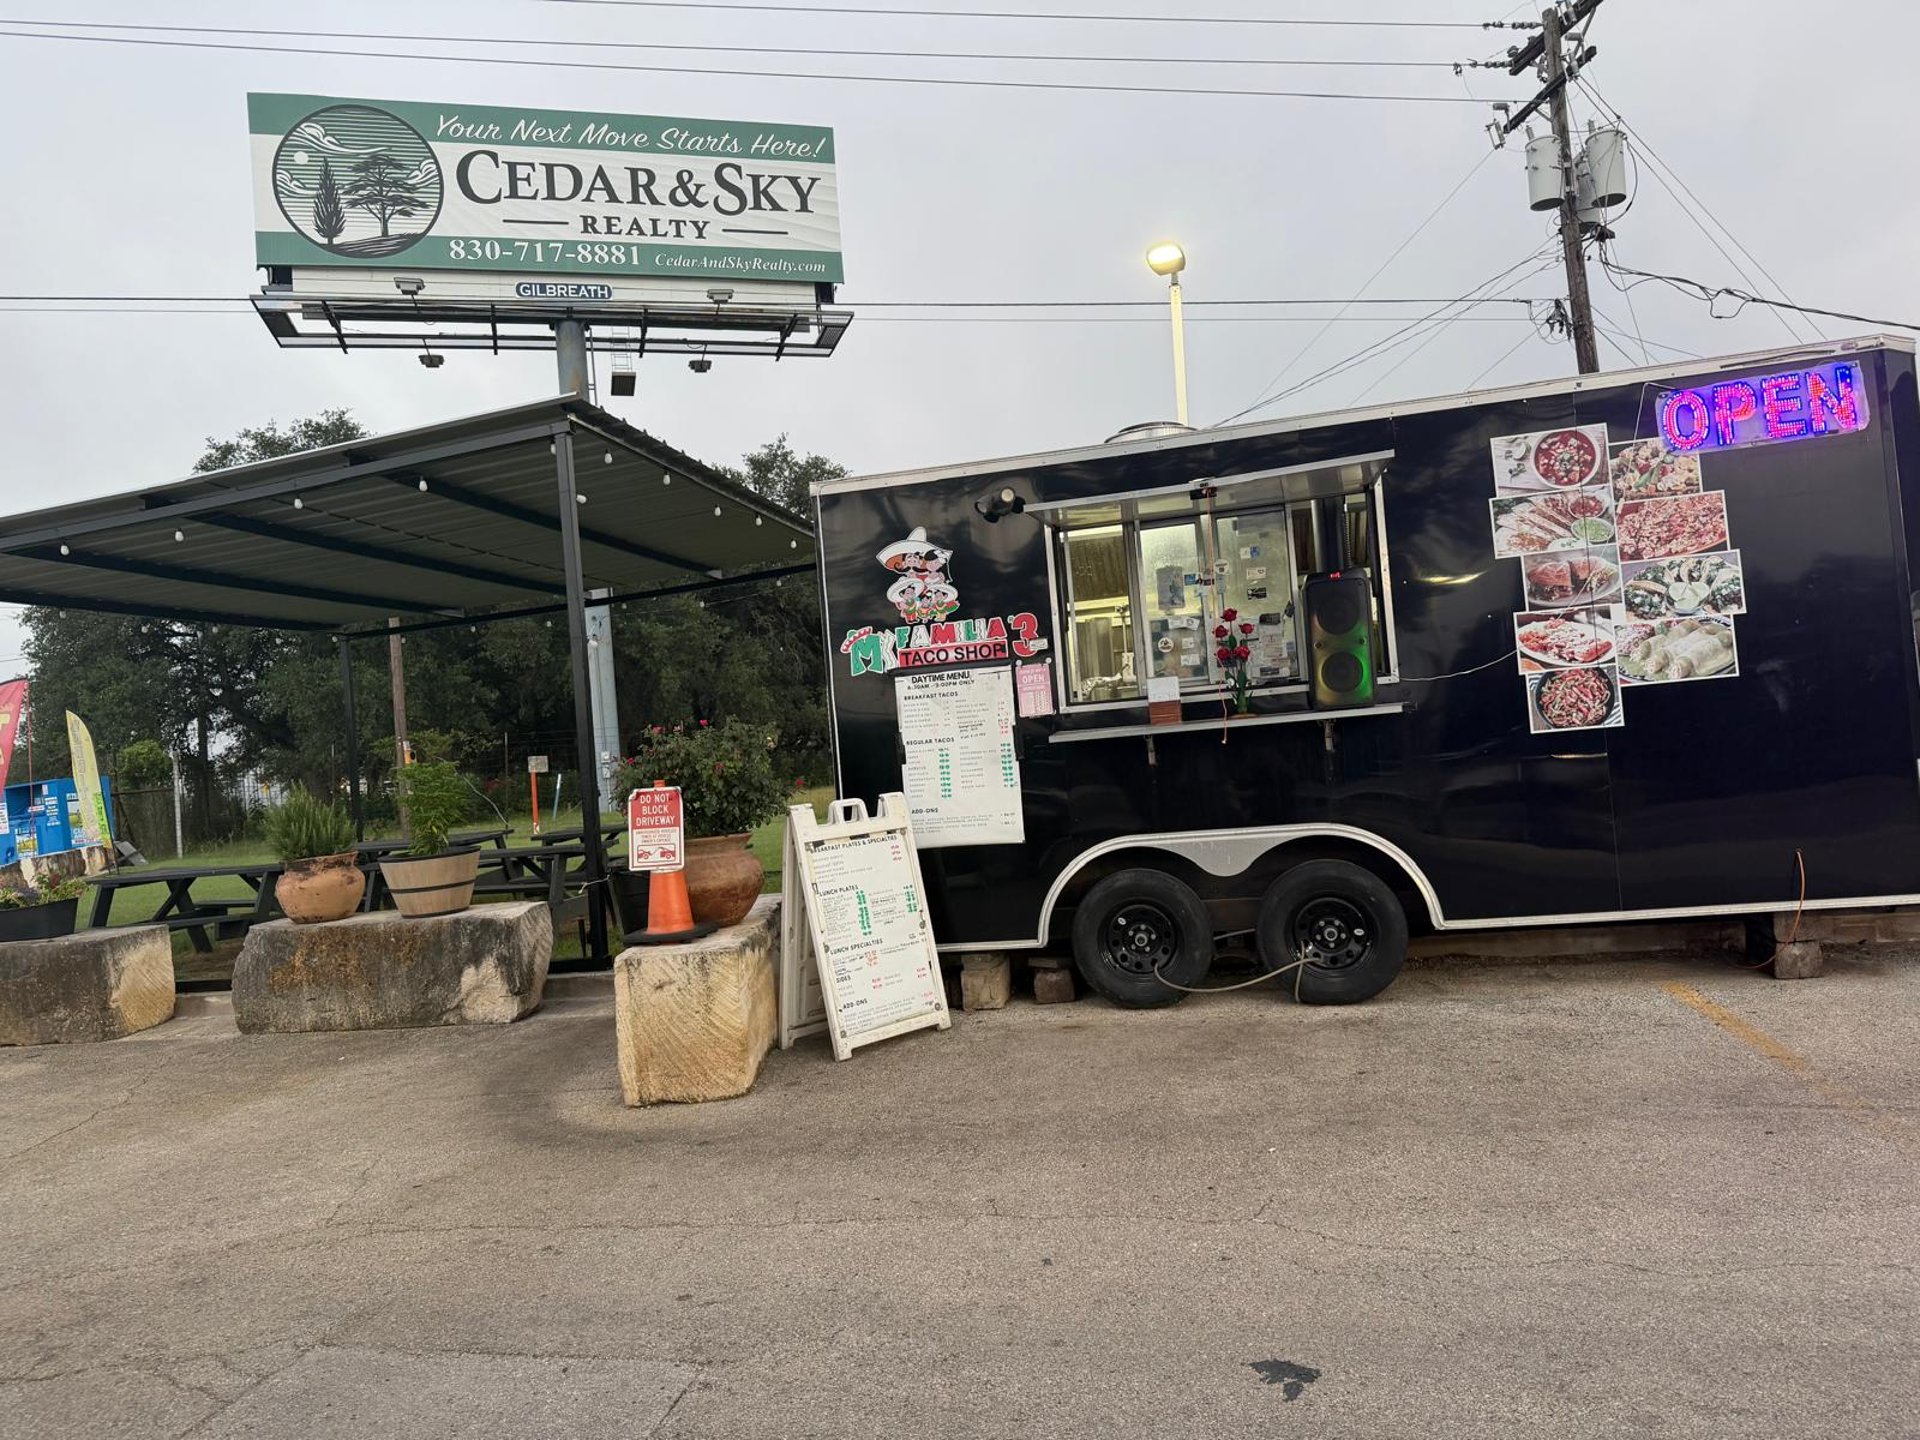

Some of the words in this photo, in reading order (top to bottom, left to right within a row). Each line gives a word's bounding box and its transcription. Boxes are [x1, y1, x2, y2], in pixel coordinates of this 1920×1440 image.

[437, 114, 502, 140] Your
[510, 119, 572, 143] Next
[578, 122, 650, 147] Move
[656, 127, 743, 153] Starts
[750, 133, 826, 157] Here!
[579, 215, 710, 239] REALTY
[449, 239, 639, 265] 830-717-8881
[655, 253, 826, 272] CedarAndSkyRealty.com
[519, 284, 609, 298] GILBREATH
[1662, 365, 1857, 450] OPEN
[895, 617, 1007, 649] FAMILIA
[1011, 612, 1039, 657] 3
[901, 650, 949, 666] TACO
[955, 643, 1005, 661] SHOP
[912, 674, 945, 683] DAYTIME
[947, 671, 970, 680] MENU
[1022, 674, 1045, 683] OPEN
[904, 692, 937, 700] BREAKFAST
[906, 738, 933, 746] REGULAR
[640, 795, 651, 804] DO
[654, 793, 670, 803] NOT
[642, 805, 669, 815] BLOCK
[636, 816, 675, 826] DRIVEWAY
[820, 888, 838, 896] LUNCH
[839, 885, 859, 893] PLATES
[830, 946, 849, 955] LUNCH
[850, 939, 883, 951] SPECIALTIES
[836, 975, 851, 983] SIDES
[843, 998, 868, 1009] ADD-ONS
